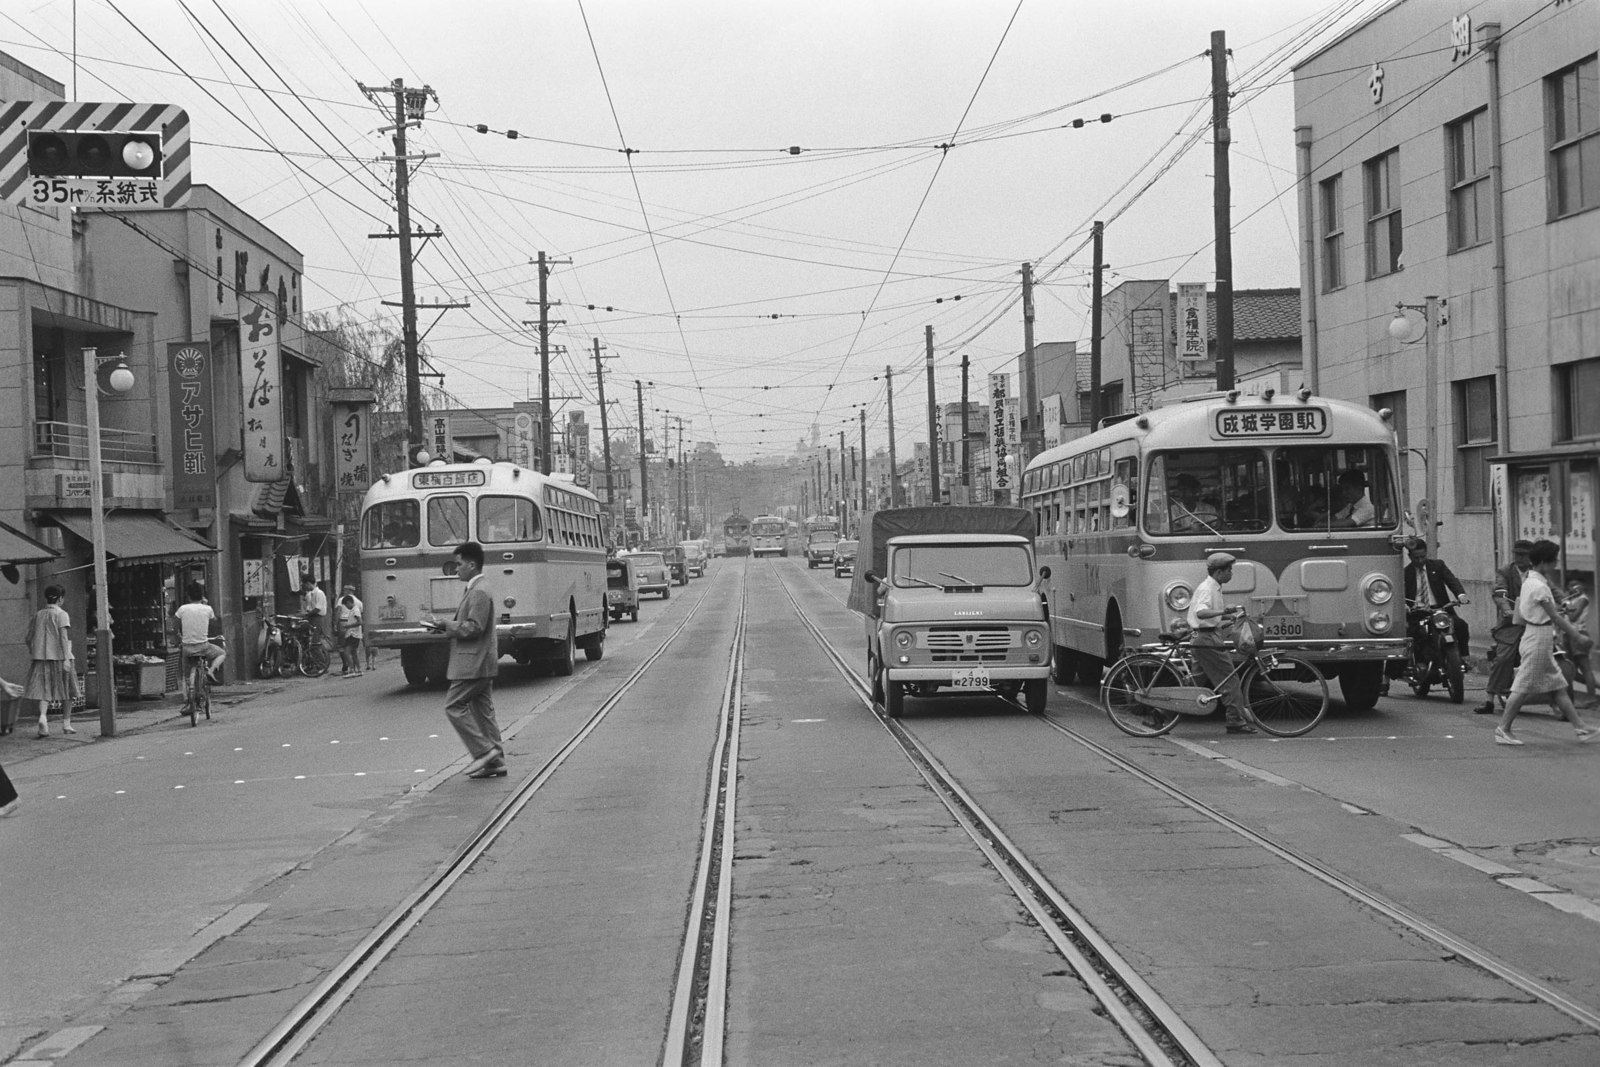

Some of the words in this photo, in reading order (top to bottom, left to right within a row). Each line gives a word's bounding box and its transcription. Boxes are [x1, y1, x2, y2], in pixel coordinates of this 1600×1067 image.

[1185, 307, 1200, 352] 食糧学院
[181, 381, 206, 475] アサヒ靴
[340, 404, 360, 462] うなぎ
[1223, 412, 1316, 433] 成城学園駅
